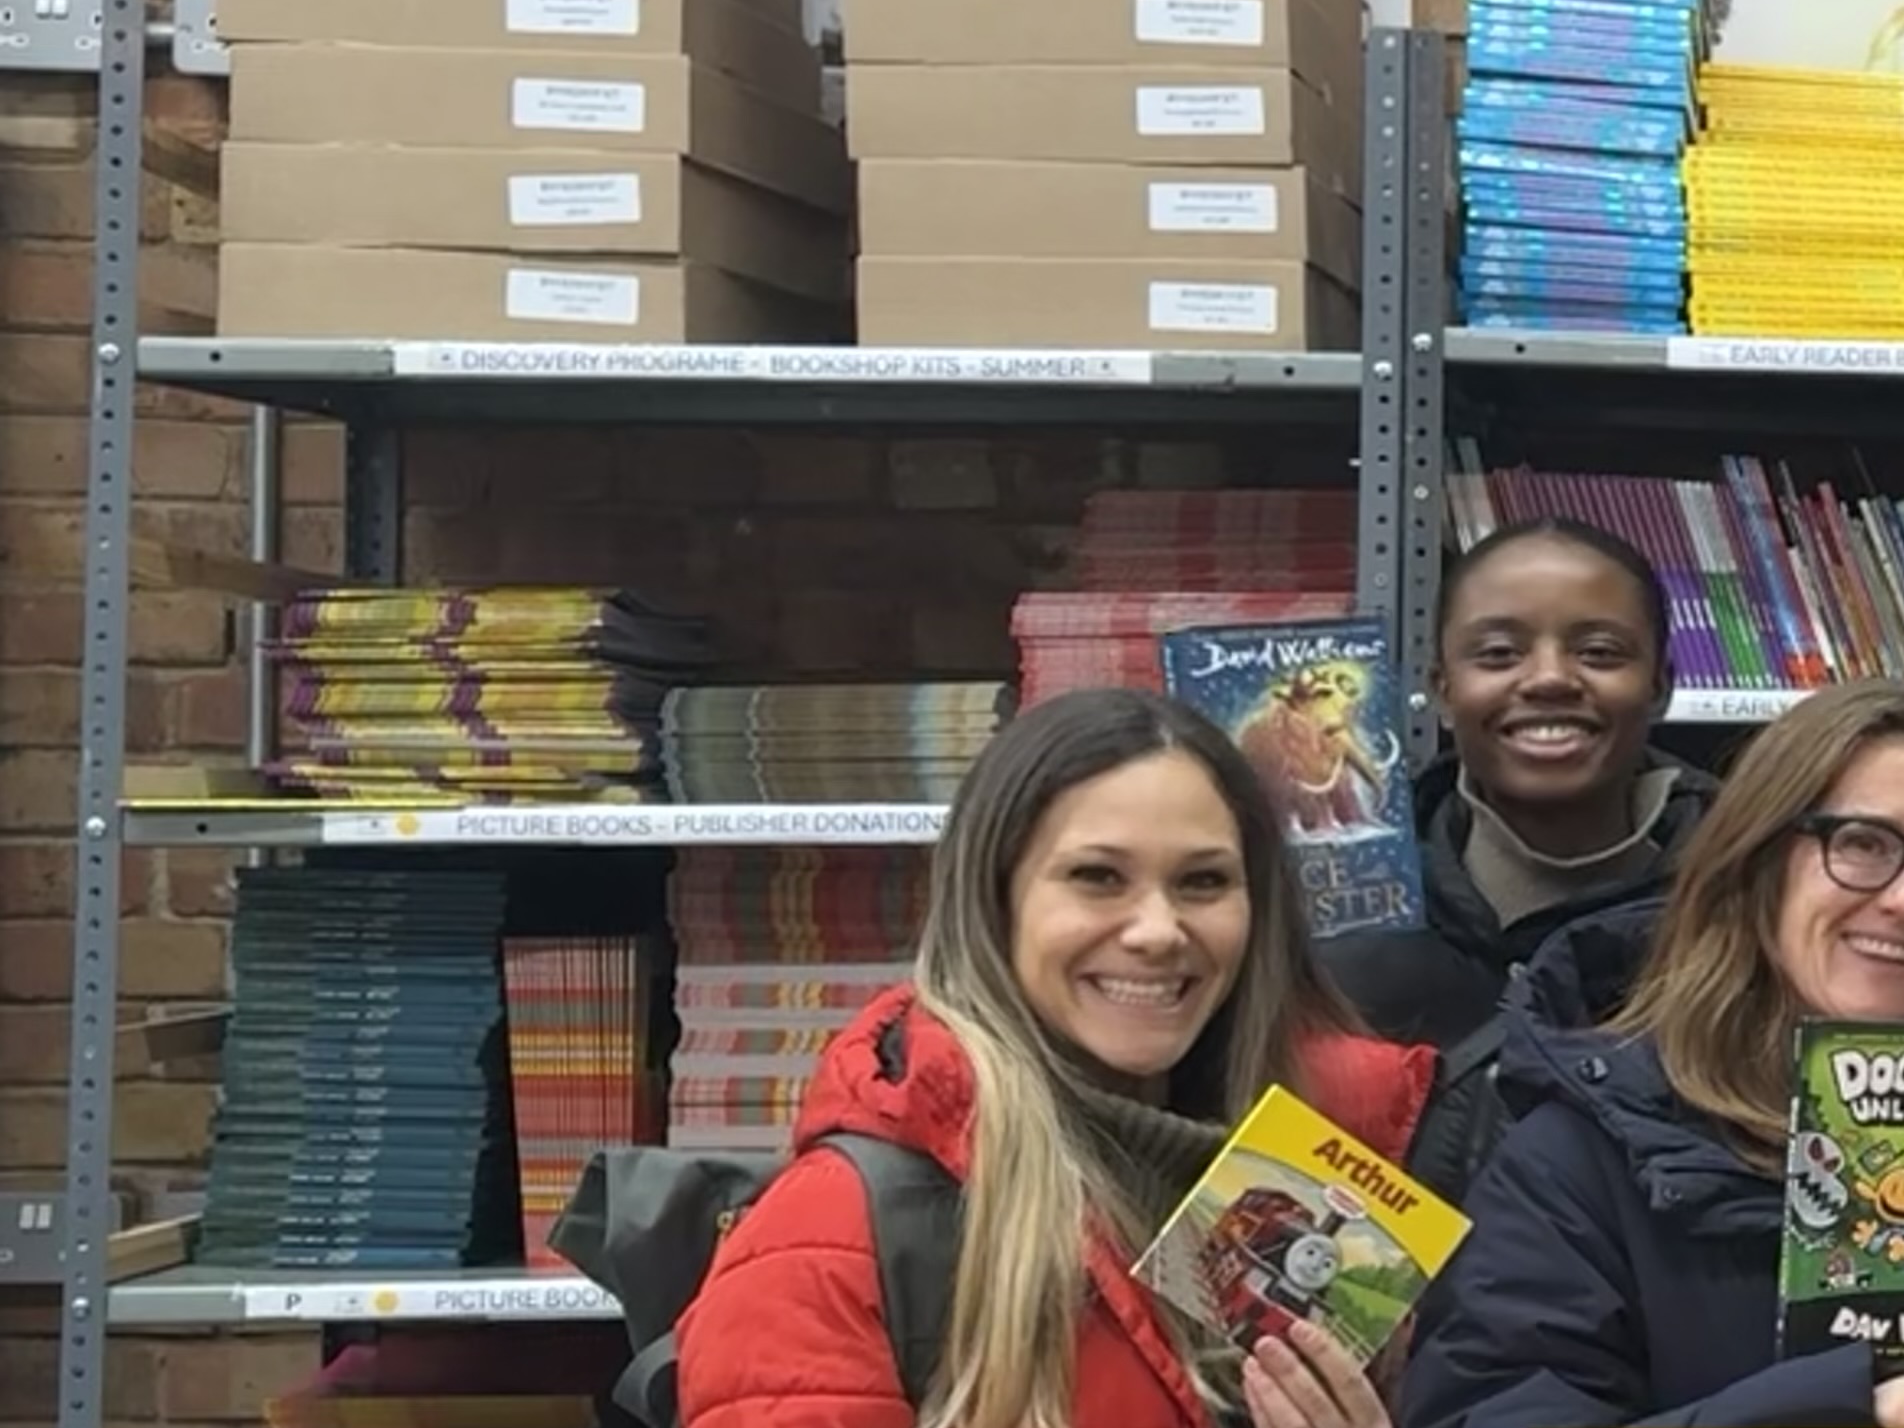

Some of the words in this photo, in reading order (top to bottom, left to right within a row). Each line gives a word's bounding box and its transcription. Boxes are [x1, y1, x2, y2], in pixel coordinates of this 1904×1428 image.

[460, 349, 598, 370] DISCOVERY
[771, 354, 906, 375] BOOKSHOP
[913, 356, 960, 376] KITS
[981, 356, 1085, 378] SUMMER
[1729, 347, 1796, 365] EARLY
[1803, 347, 1891, 367] READER
[1191, 638, 1275, 677] David
[457, 814, 561, 836] PICTURE
[567, 814, 652, 836] BOOKS
[674, 813, 808, 835] PUBLISHER
[1312, 1138, 1420, 1216] Arthur
[284, 1293, 301, 1311] P
[434, 1289, 537, 1310] PICTURE
